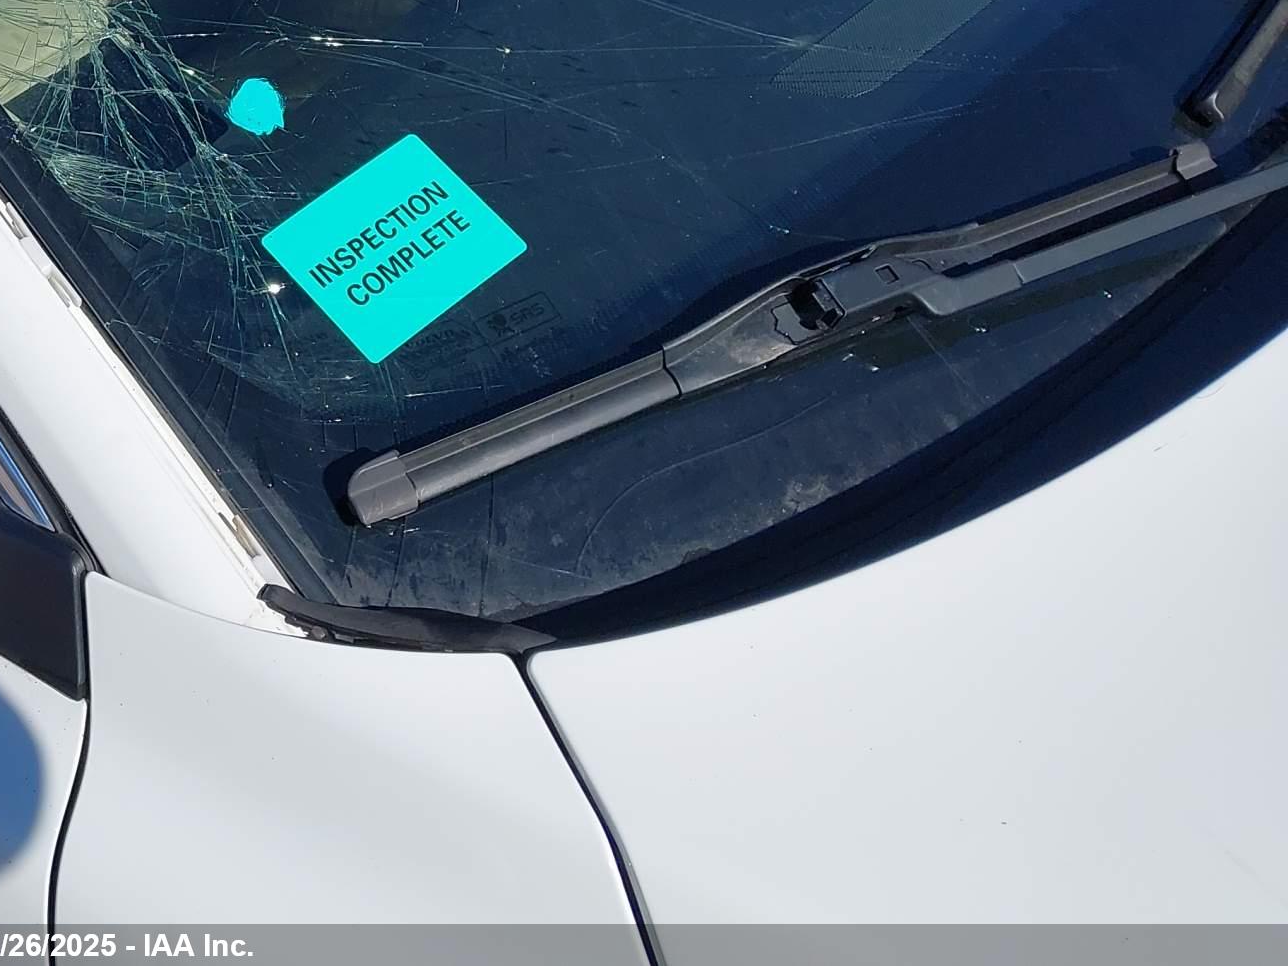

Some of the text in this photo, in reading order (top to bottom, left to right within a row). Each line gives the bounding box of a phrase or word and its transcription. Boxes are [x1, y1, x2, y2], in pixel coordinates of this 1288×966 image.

[309, 180, 450, 289] INSPECTION
[346, 209, 471, 306] COMPLETE
[509, 303, 545, 328] SRS
